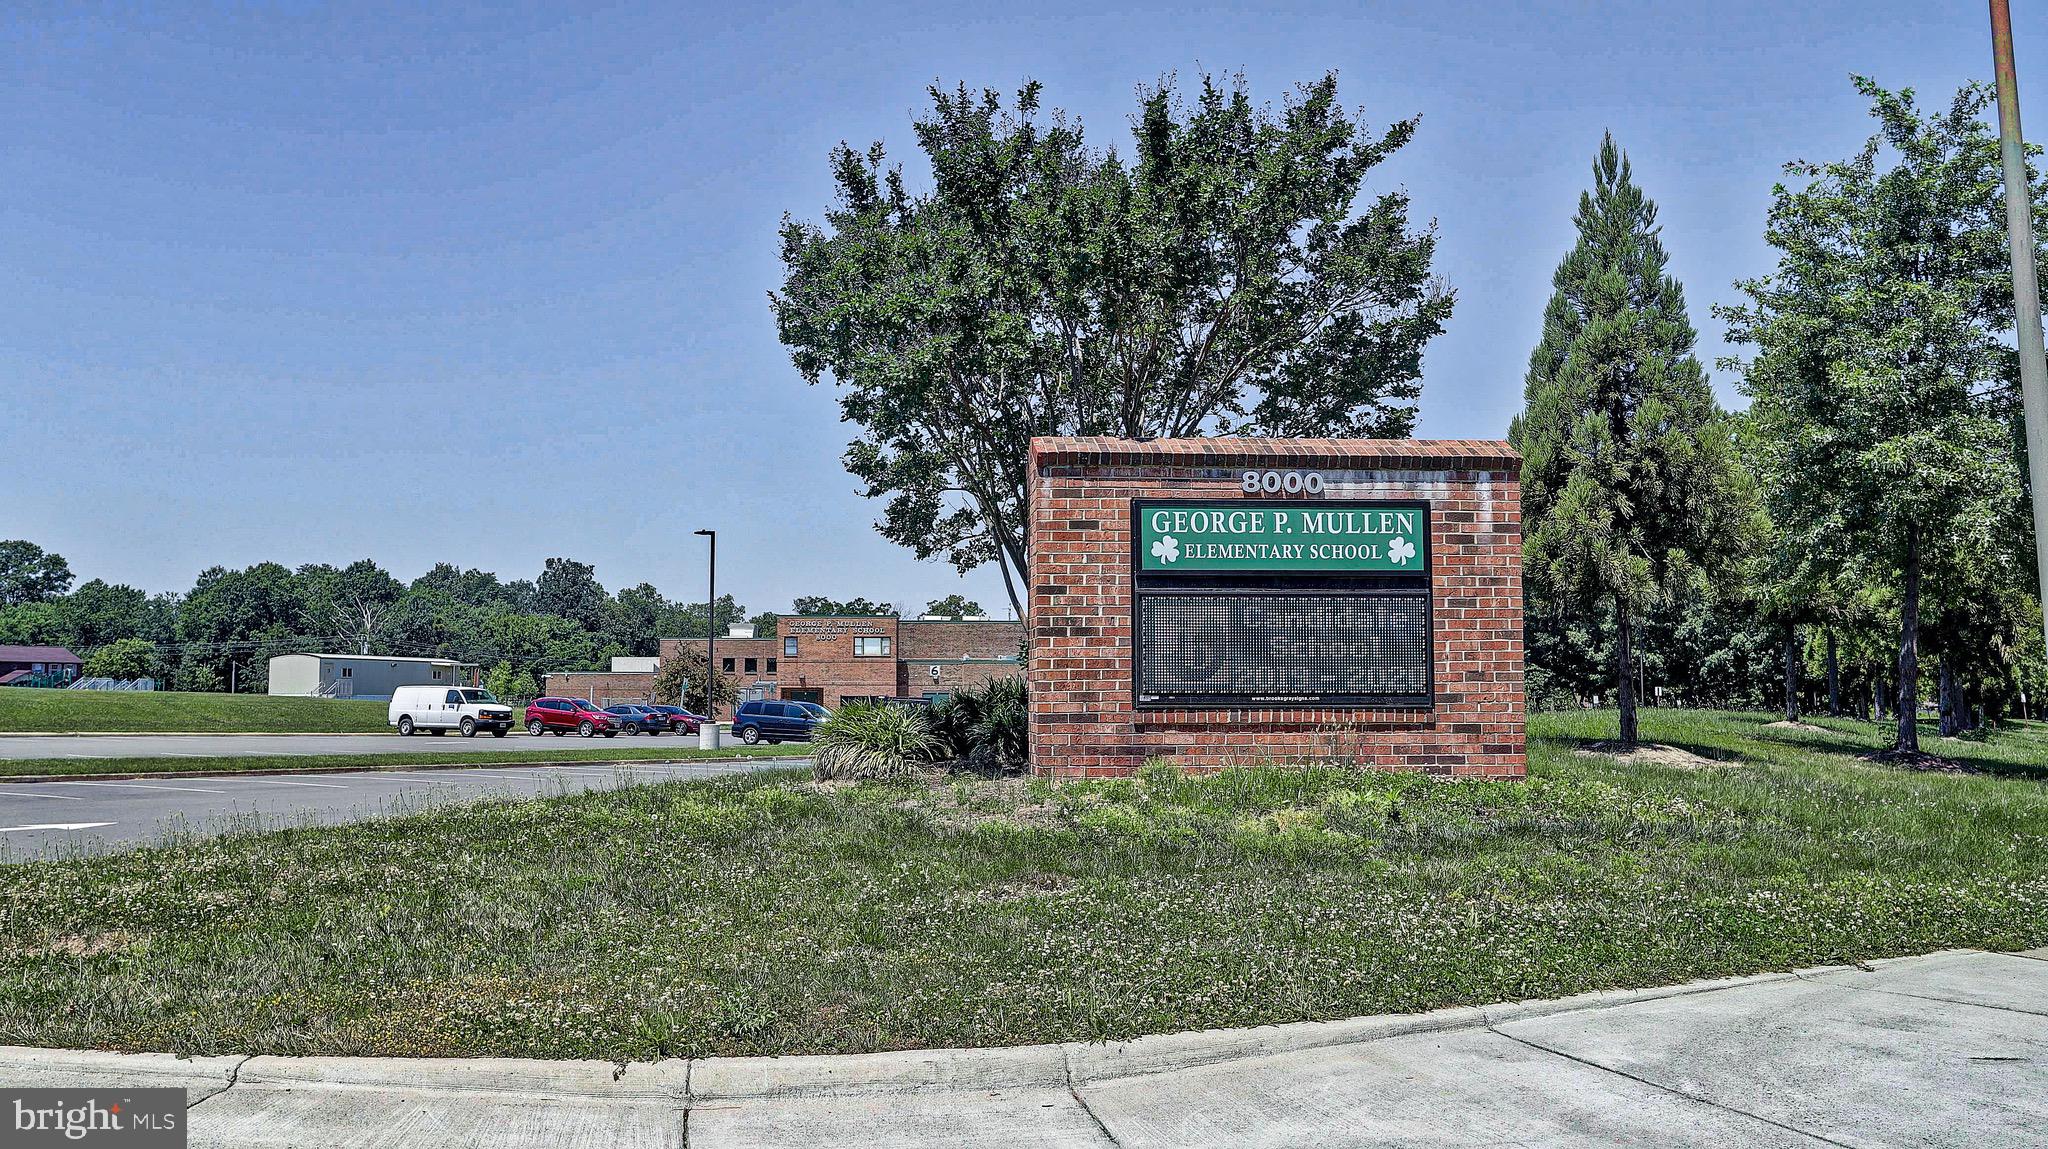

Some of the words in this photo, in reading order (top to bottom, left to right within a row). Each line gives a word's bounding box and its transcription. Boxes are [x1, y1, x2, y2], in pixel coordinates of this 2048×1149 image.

[1241, 471, 1325, 494] 8000
[1151, 510, 1265, 534] GEORGE
[1273, 511, 1293, 534] P.
[1301, 512, 1414, 535] MULLEN
[1184, 543, 1303, 560] ELEMENTARY
[1310, 543, 1383, 561] SCHOOL
[931, 666, 939, 675] 6
